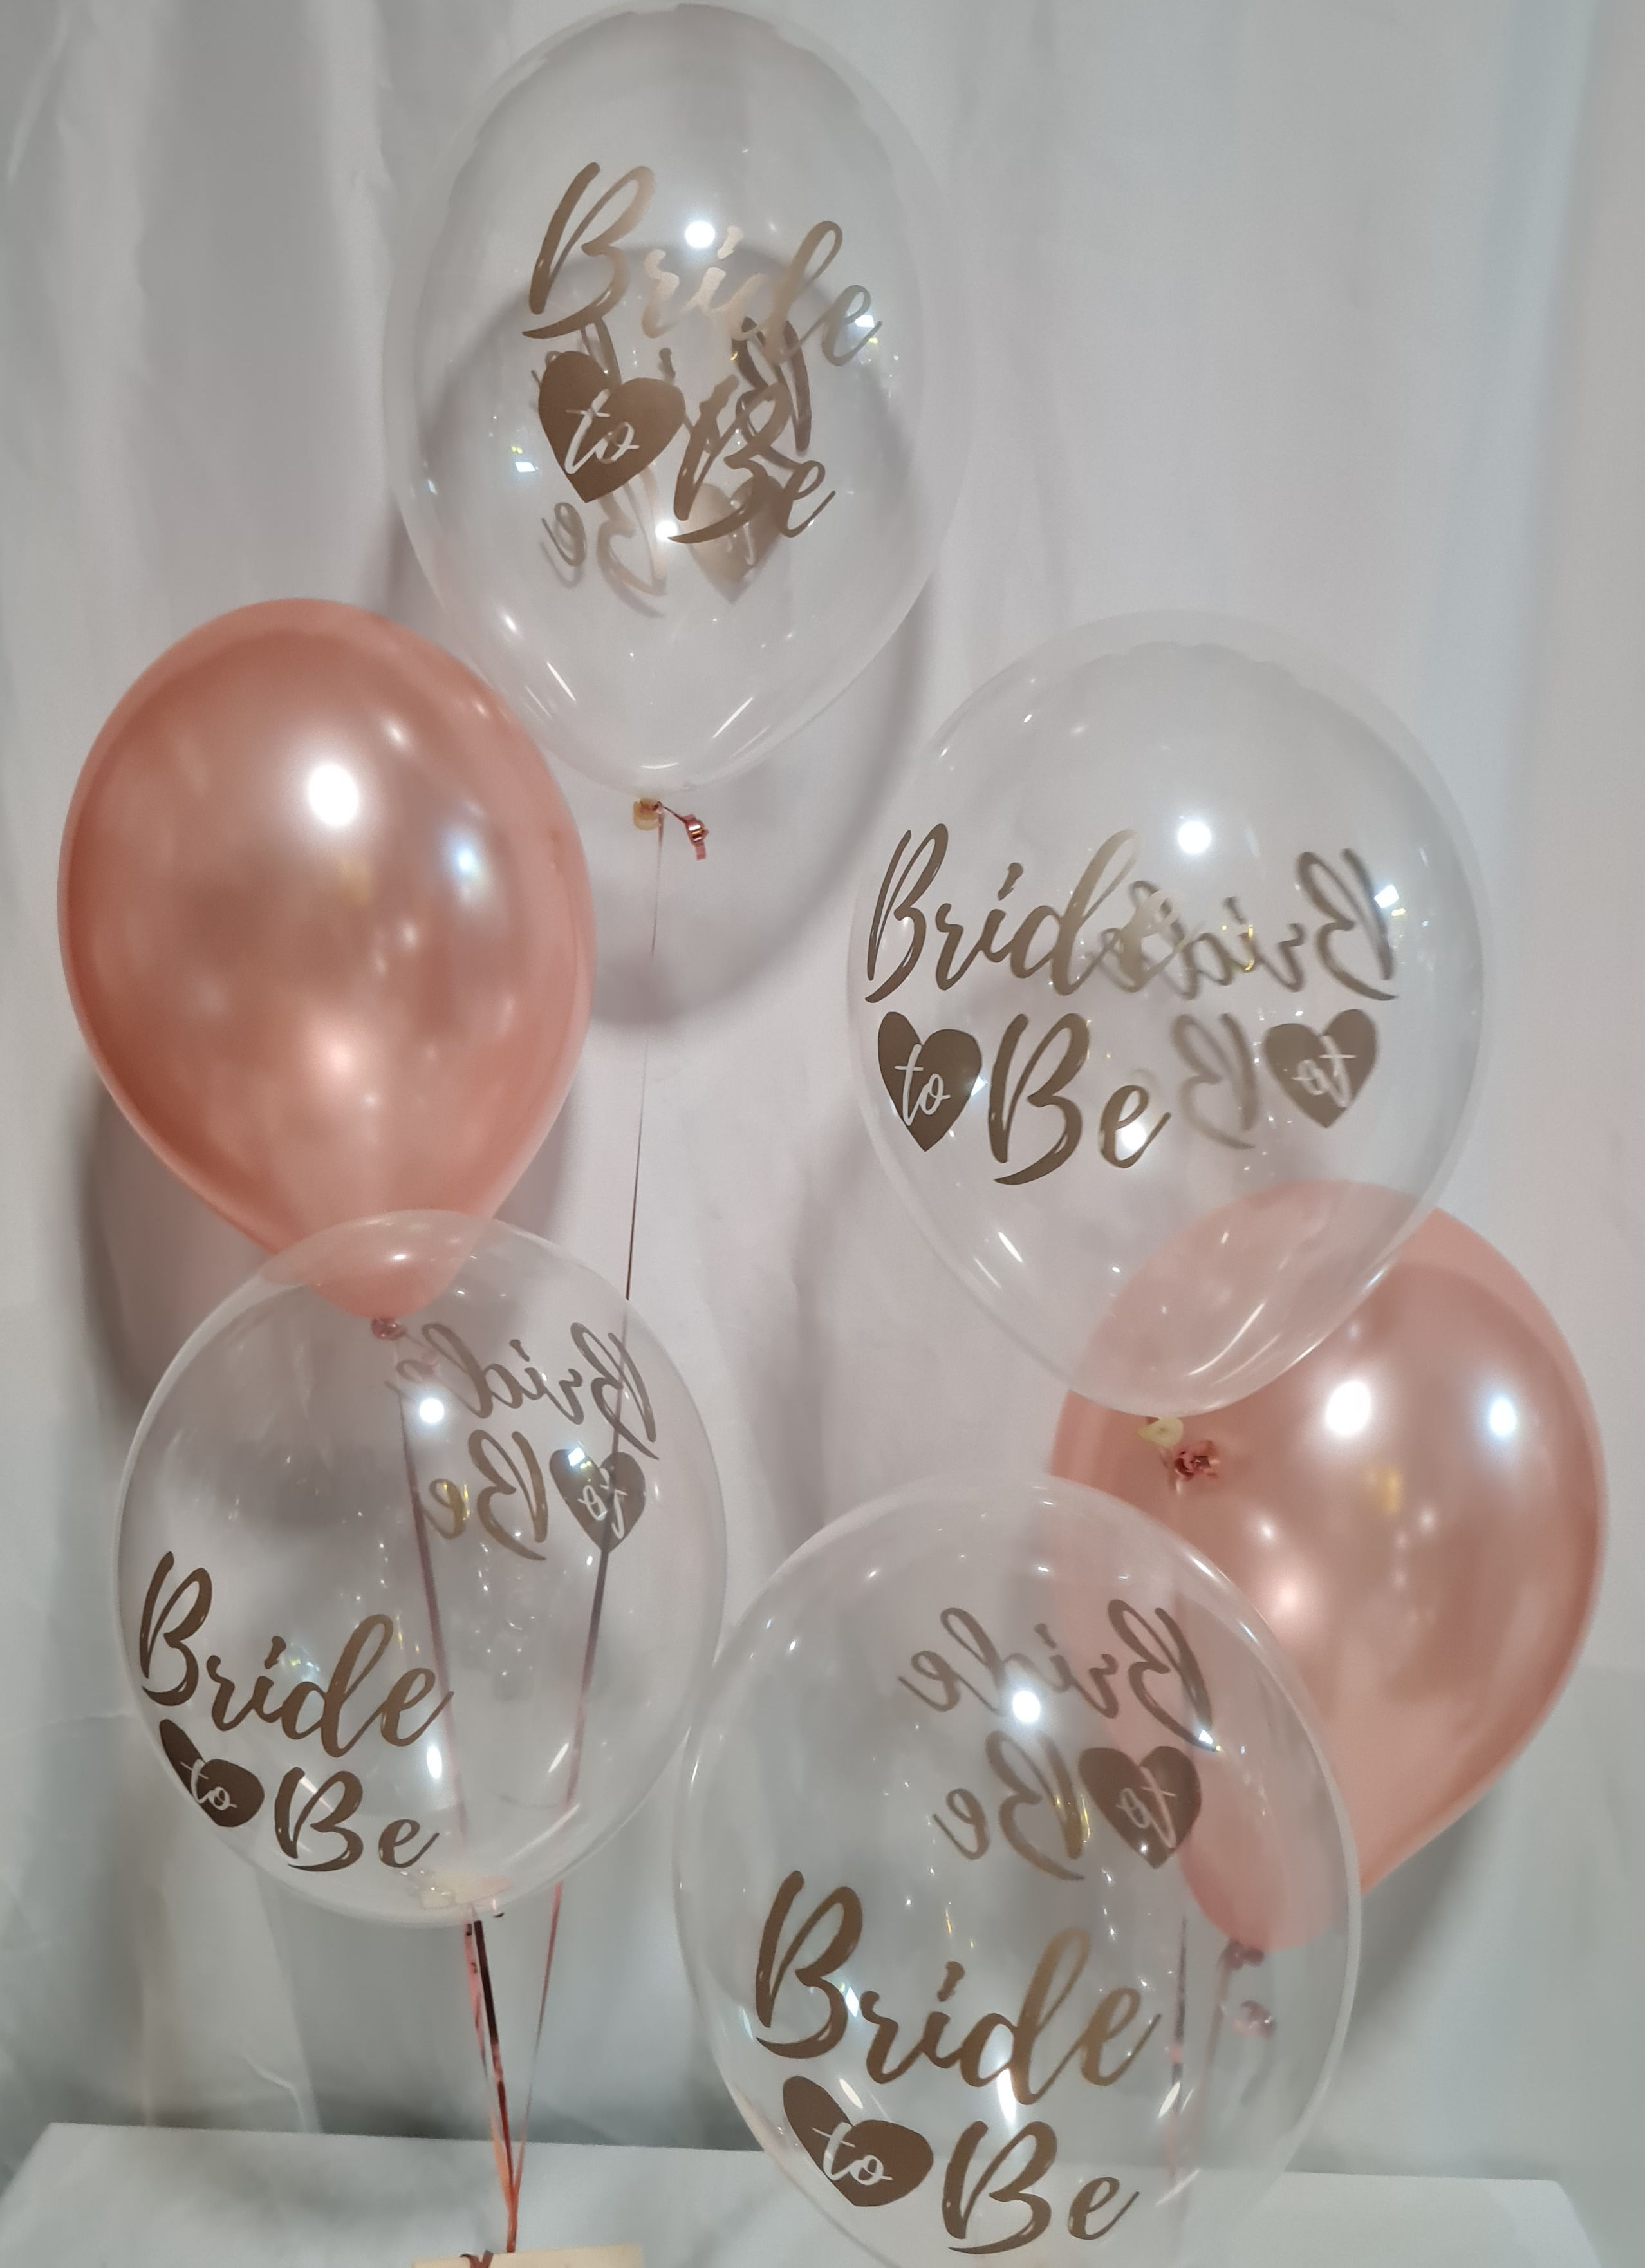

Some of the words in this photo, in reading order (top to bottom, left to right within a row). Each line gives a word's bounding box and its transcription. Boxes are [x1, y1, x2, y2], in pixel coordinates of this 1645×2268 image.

[523, 162, 882, 366] Bride
[566, 389, 640, 474] to
[667, 374, 835, 544] Be
[865, 823, 1206, 1004] Bride
[895, 1044, 951, 1127] to
[989, 1013, 1171, 1185] Be
[139, 1551, 454, 1758] Bride
[180, 1758, 237, 1810] to
[274, 1767, 440, 1872] Be
[756, 1870, 1162, 2105] Bride
[812, 2121, 893, 2185] to
[942, 2120, 1140, 2254] Be
